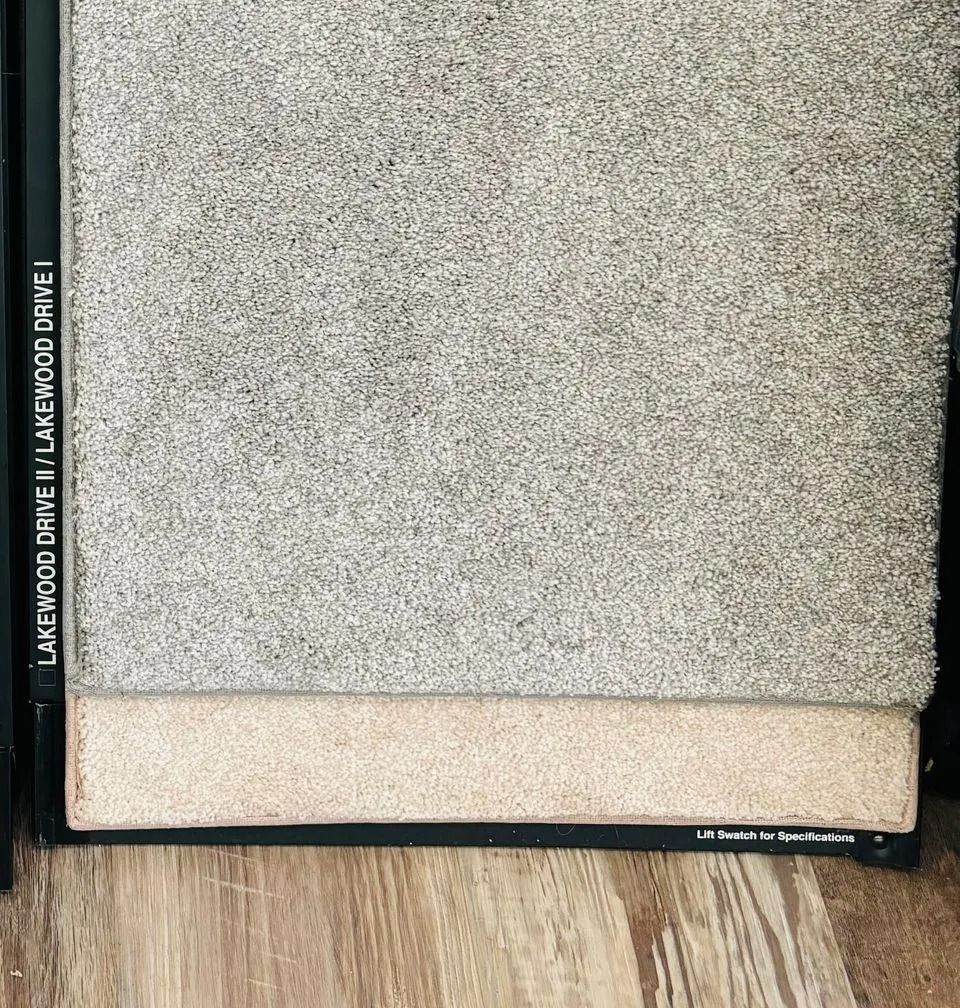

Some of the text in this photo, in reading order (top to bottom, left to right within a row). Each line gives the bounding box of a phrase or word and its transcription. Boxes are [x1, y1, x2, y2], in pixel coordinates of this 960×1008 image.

[33, 272, 54, 332] DRIVE
[34, 337, 55, 453] LAKEWOOD
[35, 470, 55, 480] II
[35, 486, 56, 545] DRIVE
[36, 550, 58, 665] LAKEWOOD
[696, 829, 856, 844] Lift Swatch for Specifications
